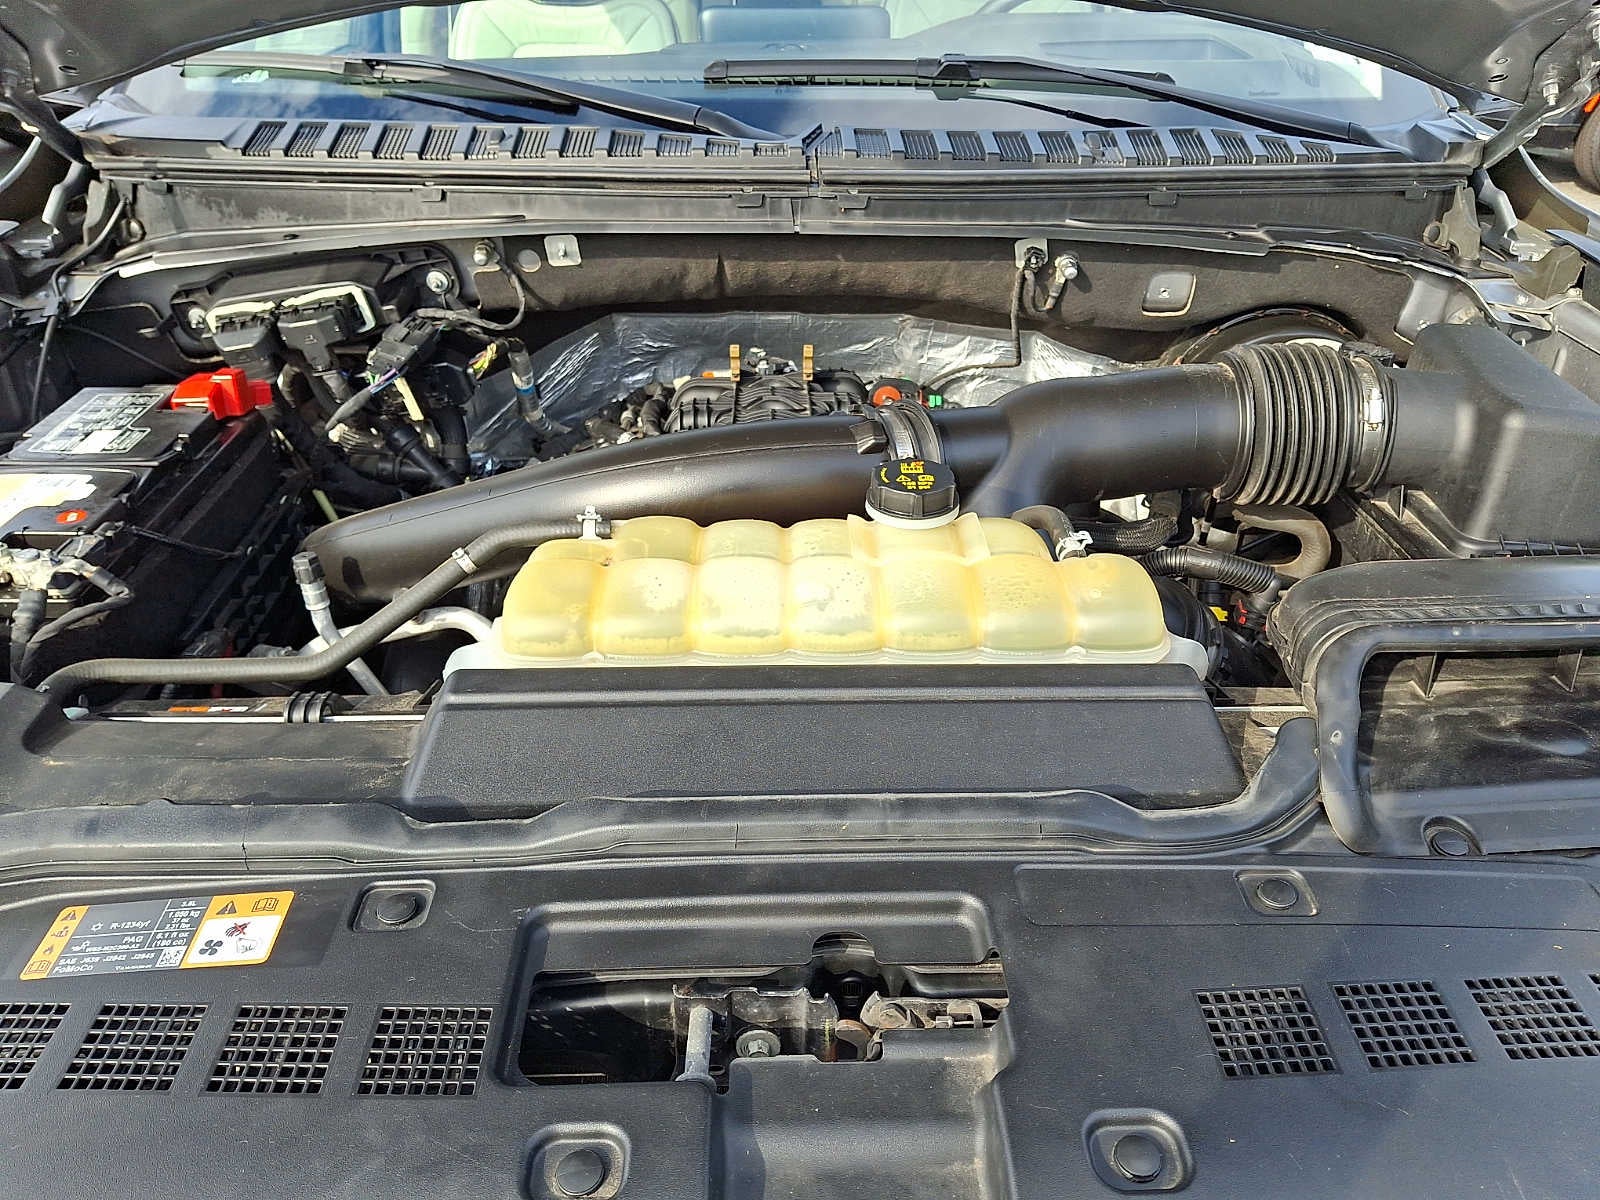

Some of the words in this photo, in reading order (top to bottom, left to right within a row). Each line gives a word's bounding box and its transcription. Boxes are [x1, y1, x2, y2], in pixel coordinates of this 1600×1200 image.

[189, 910, 201, 918] kg
[110, 920, 151, 930] R-1234yf
[122, 935, 144, 944] PAG
[58, 957, 77, 966] SAE
[52, 964, 94, 975] FoMoCo
